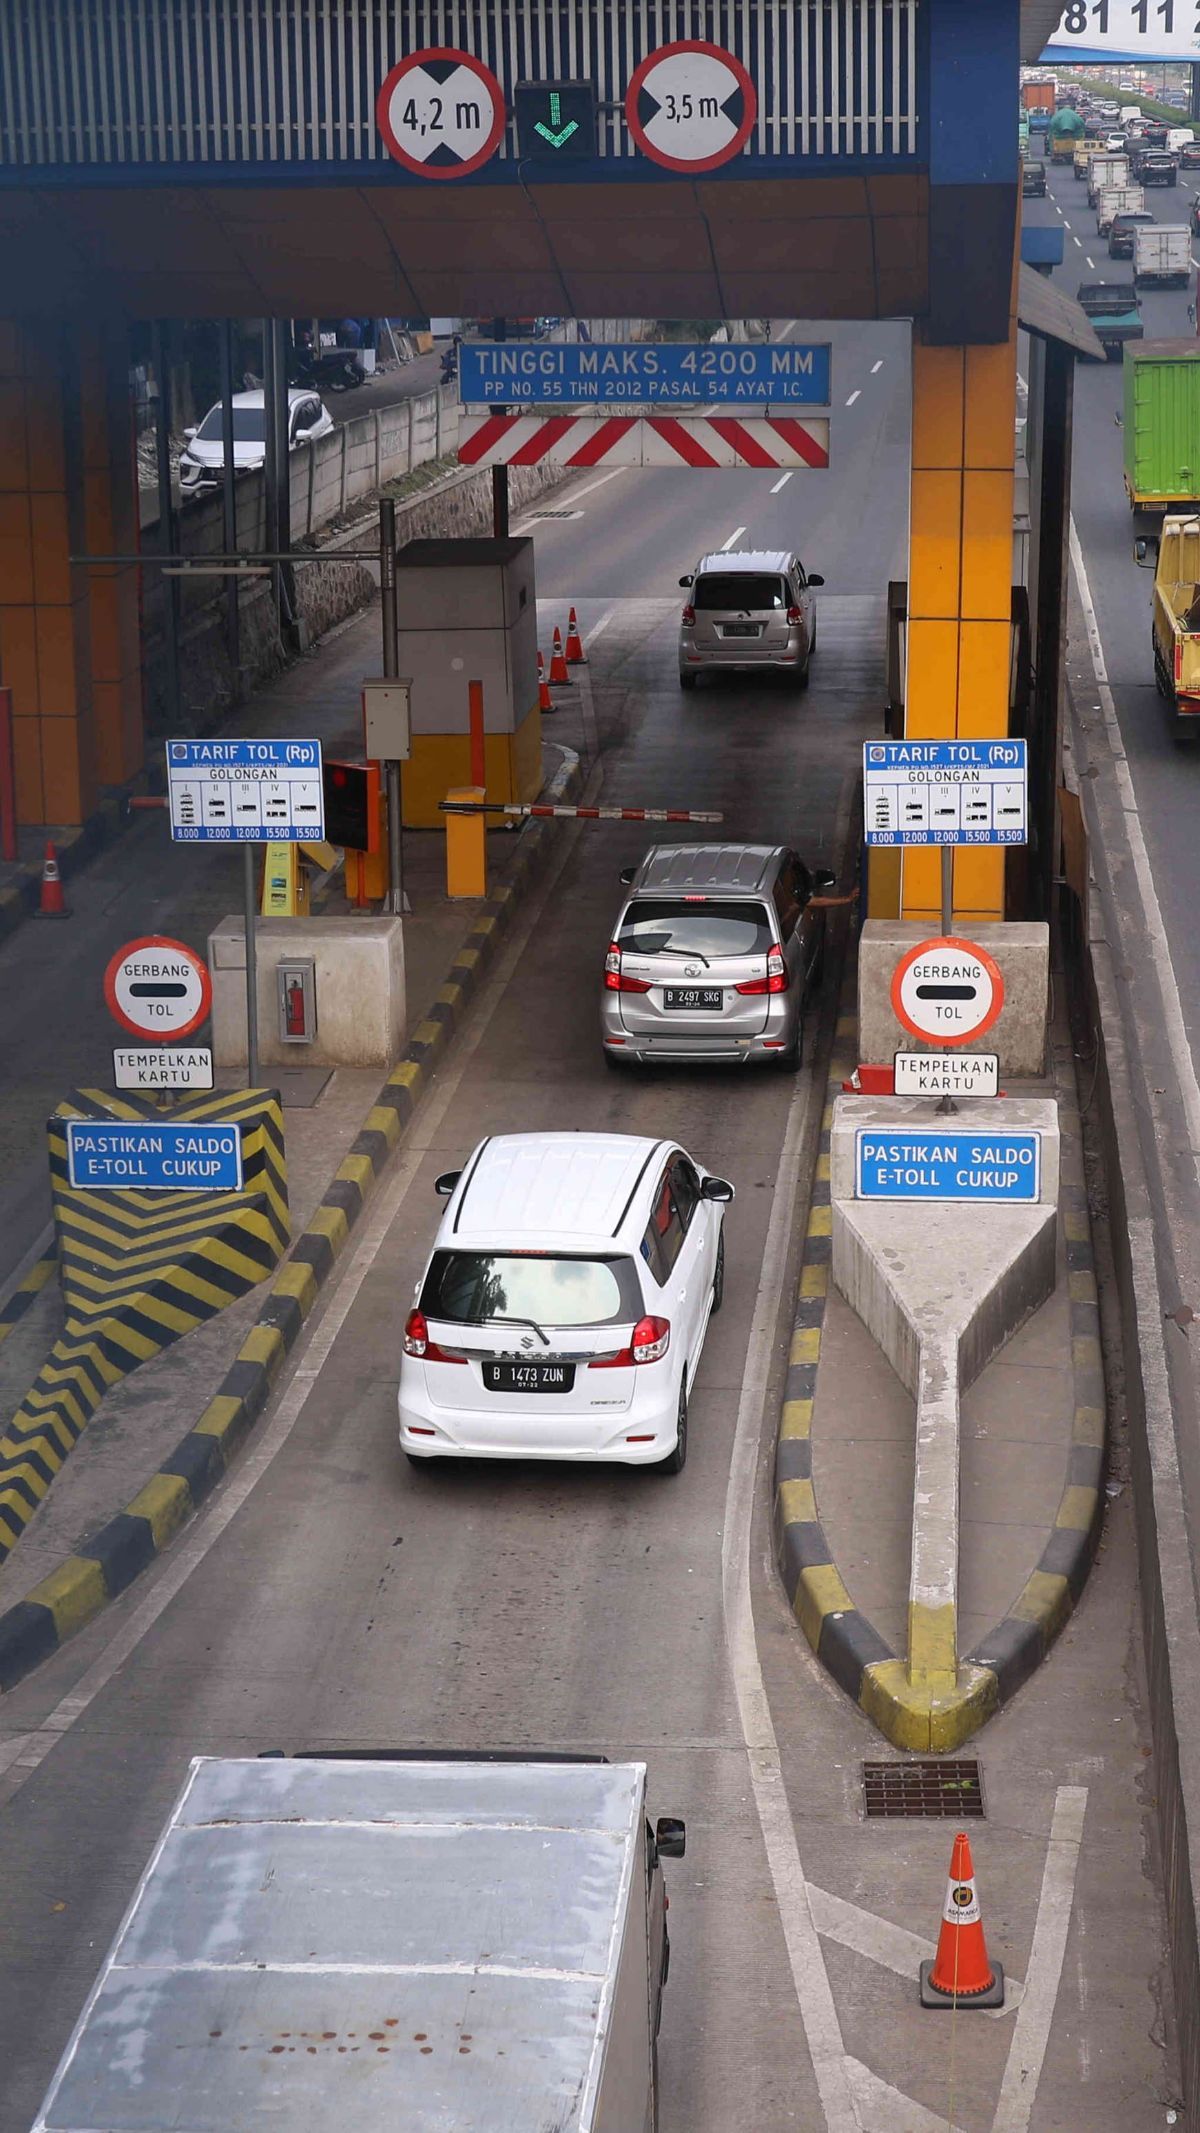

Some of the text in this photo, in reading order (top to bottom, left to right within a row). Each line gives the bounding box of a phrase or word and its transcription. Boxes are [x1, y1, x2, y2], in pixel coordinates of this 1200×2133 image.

[665, 94, 719, 124] 3,5 m
[402, 98, 480, 136] 4,2 m
[475, 351, 813, 375] TINGGI MAKS. 4200 MM
[485, 381, 504, 396] PP
[512, 381, 535, 396] NO.
[542, 381, 562, 396] 55
[570, 381, 598, 396] THN
[605, 381, 642, 396] 2012
[649, 381, 700, 396] PASAL
[708, 381, 728, 396] 54
[736, 381, 774, 396] AYAT
[191, 745, 315, 763] TARIF TOL (Rp)
[889, 746, 1019, 764] TARIF TOL (Rp)
[209, 769, 278, 780] GOLONGAN
[908, 771, 980, 782] GOLONGAN
[178, 828, 320, 838] 8.000 12.000 12.000 15.500 15.500
[872, 831, 1022, 843] 8.000 12.000 12.000 15.500 15.500
[124, 964, 190, 977] GERBANG
[913, 966, 981, 978] GERBANG
[667, 991, 720, 1002] B 2497 SKG
[147, 1004, 174, 1016] TOL
[935, 1007, 962, 1019] TOL
[118, 1055, 209, 1067] TEMPELKAN
[900, 1060, 994, 1073] TEMPELKAN
[139, 1071, 190, 1082] KARTU
[919, 1077, 974, 1089] KARTU
[74, 1137, 233, 1154] PASTIKAN SALDO
[864, 1145, 1033, 1164] PASTIKAN SALDO
[88, 1160, 221, 1176] E-TOLL CUKUP
[877, 1168, 1019, 1188] E-TOLL CUKUP
[493, 1366, 564, 1382] B 1473 ZUN
